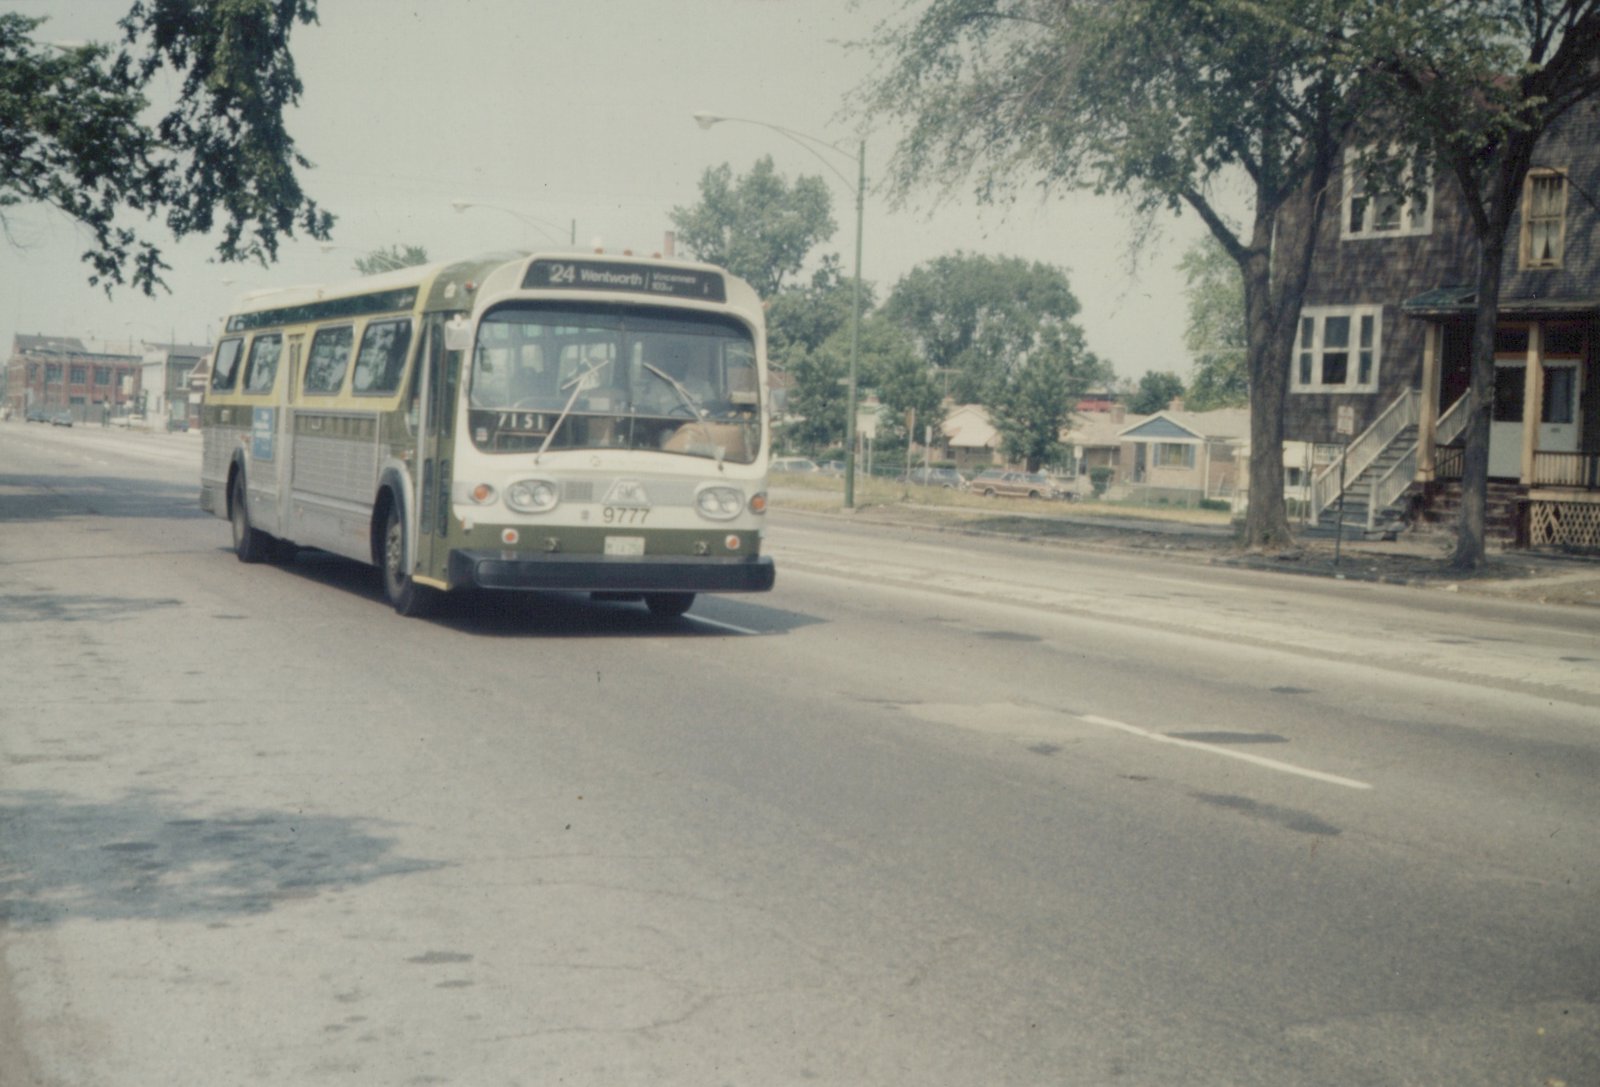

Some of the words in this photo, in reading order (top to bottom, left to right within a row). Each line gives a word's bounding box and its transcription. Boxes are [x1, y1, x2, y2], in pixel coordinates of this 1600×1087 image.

[550, 264, 575, 282] 24
[580, 267, 642, 286] Wentworth
[498, 412, 543, 430] 7151
[602, 506, 651, 525] 9777
